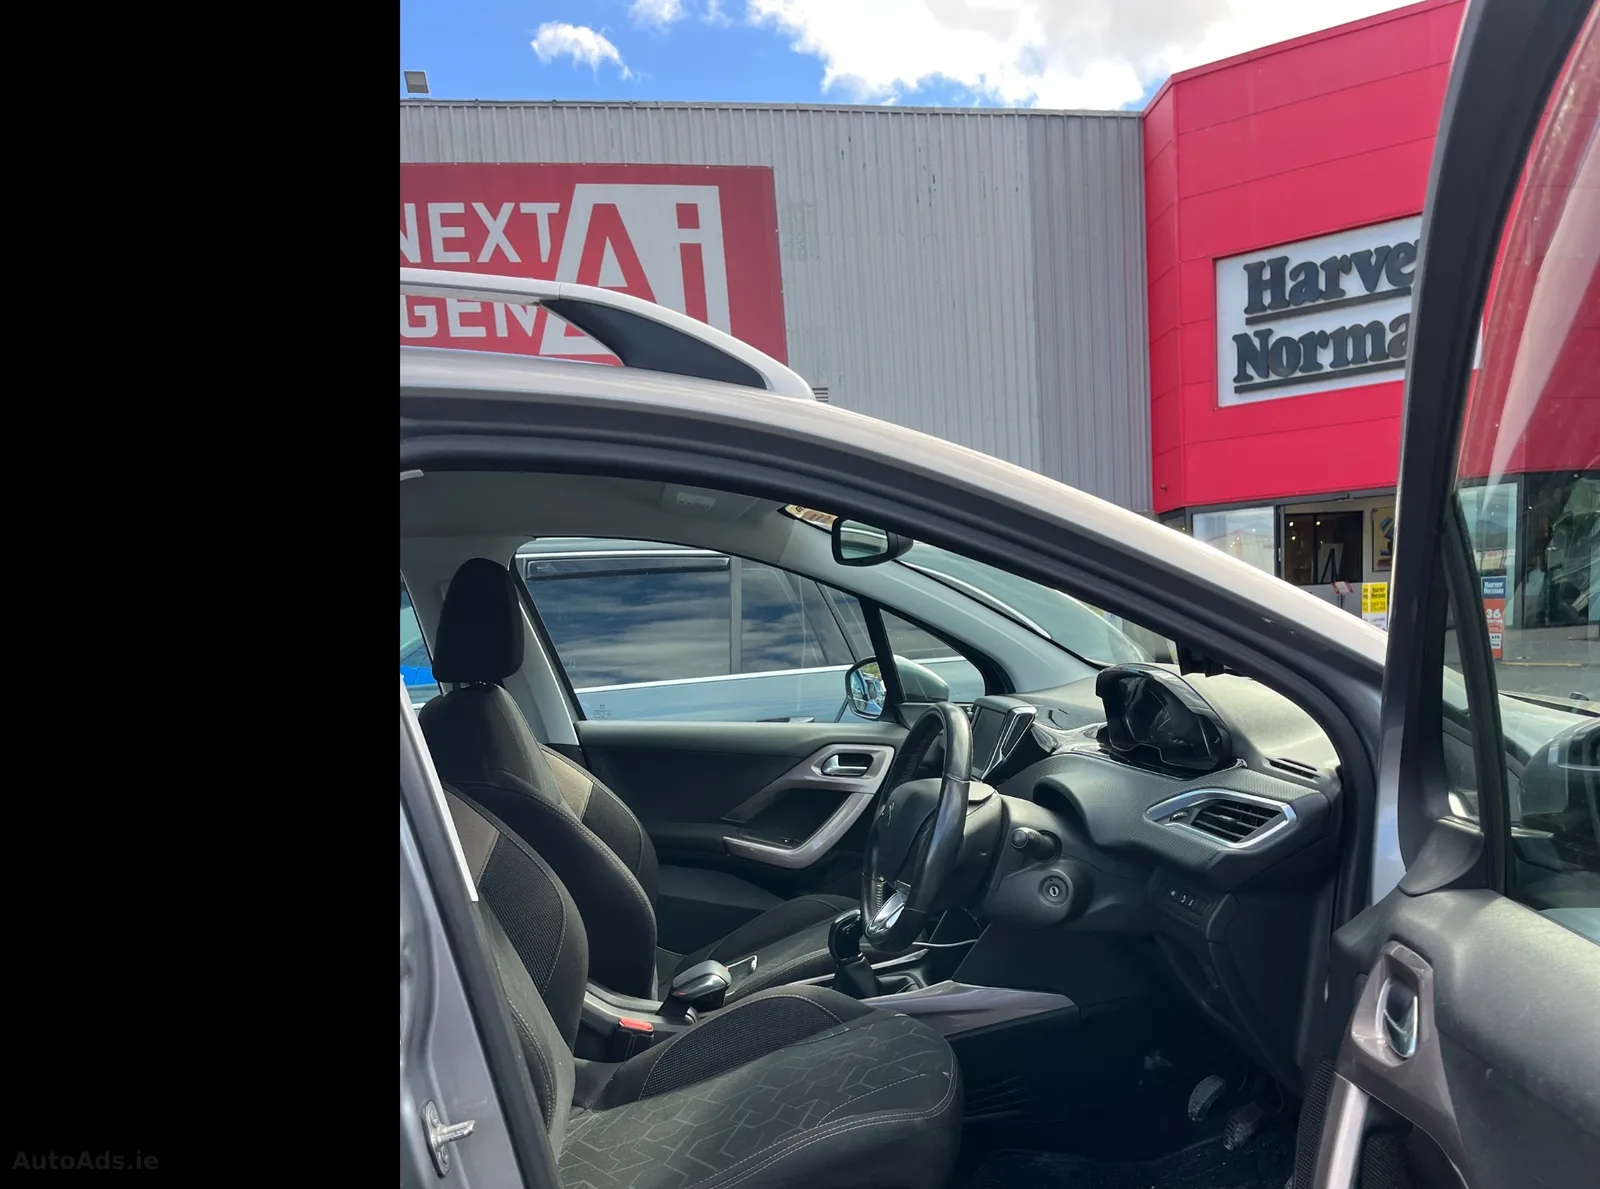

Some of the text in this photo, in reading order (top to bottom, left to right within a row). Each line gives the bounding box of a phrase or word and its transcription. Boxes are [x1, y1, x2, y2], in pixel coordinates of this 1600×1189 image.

[1243, 239, 1420, 315] Harve
[400, 294, 538, 338] GEN
[1232, 312, 1410, 384] Norma
